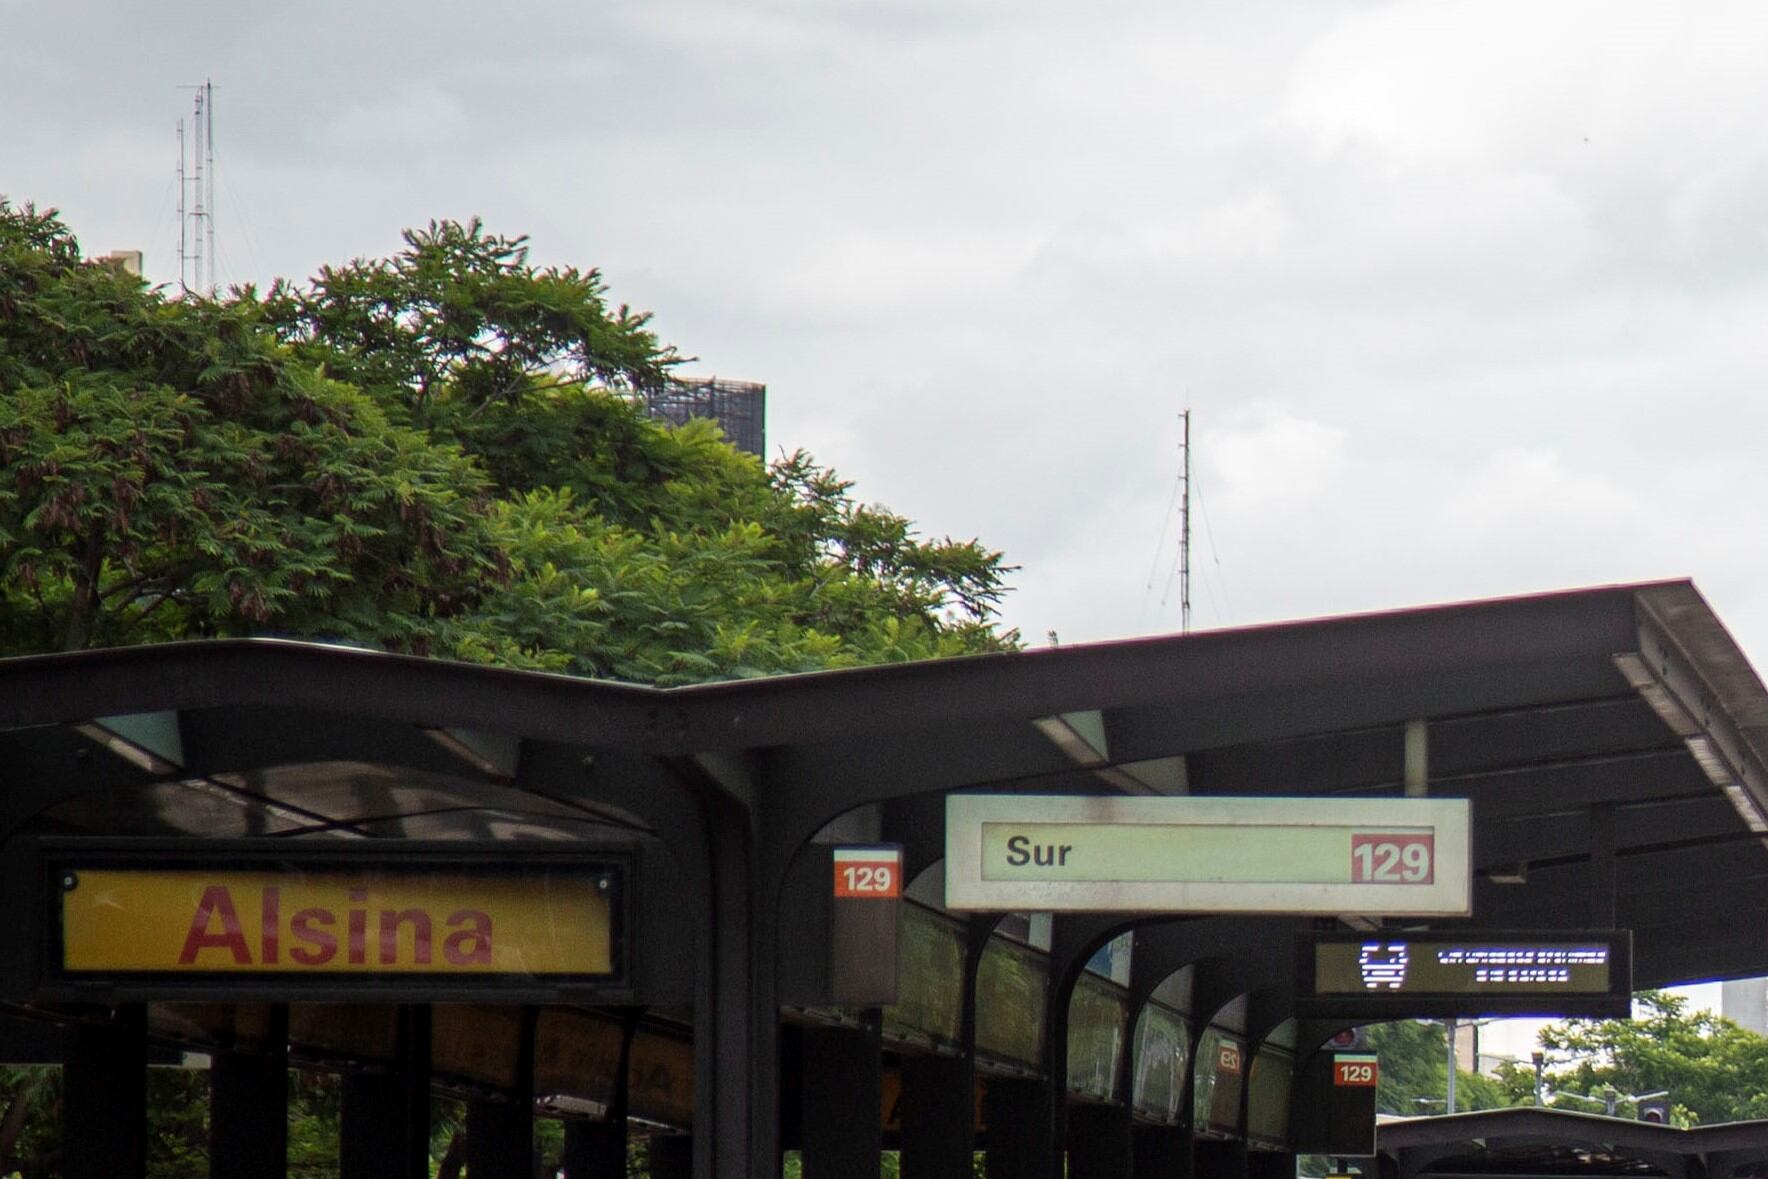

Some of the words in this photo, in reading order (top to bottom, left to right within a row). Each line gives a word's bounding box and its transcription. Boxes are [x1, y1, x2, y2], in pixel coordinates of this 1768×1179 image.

[1007, 836, 1072, 867] Sur
[1352, 842, 1431, 882] 129
[843, 867, 891, 892] 129
[178, 885, 495, 966] Alsina
[1340, 1065, 1372, 1082] 129
